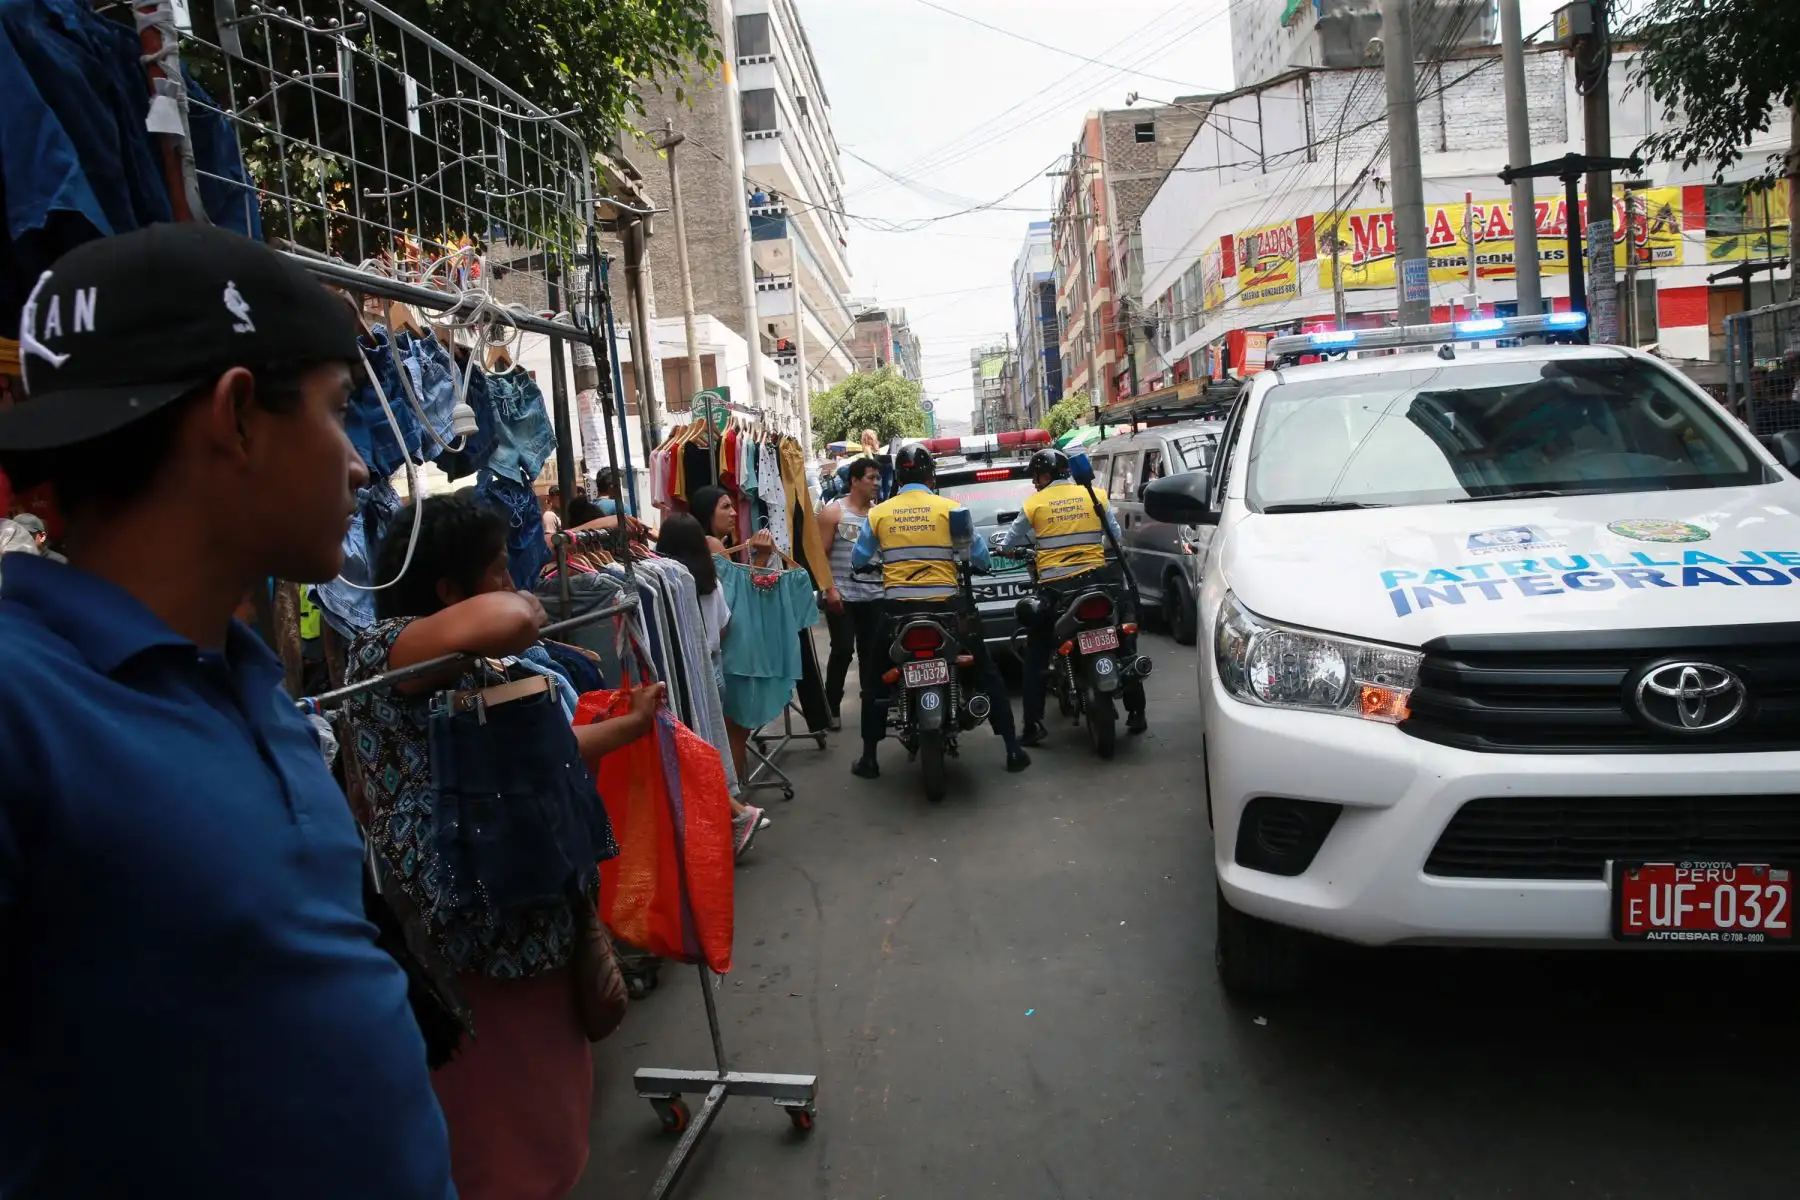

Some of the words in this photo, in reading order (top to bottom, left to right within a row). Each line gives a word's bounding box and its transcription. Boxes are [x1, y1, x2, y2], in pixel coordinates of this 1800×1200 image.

[1049, 497, 1084, 506] INSPECTOR
[893, 506, 931, 515] INSPECTOR
[1052, 505, 1085, 514] MUNICIPAL
[1057, 512, 1090, 522] TRANSPORTE
[899, 524, 936, 532] TRANSPORTE
[1381, 551, 1800, 589] PATRULLAJE
[917, 662, 935, 670] PERU
[1100, 660, 1110, 673] 25
[909, 667, 946, 683] EU-0379
[926, 694, 935, 708] 19
[1675, 868, 1736, 882] PERU
[1630, 898, 1643, 926] E
[1650, 884, 1787, 929] UF-032
[1647, 932, 1720, 941] AUTOESPAR
